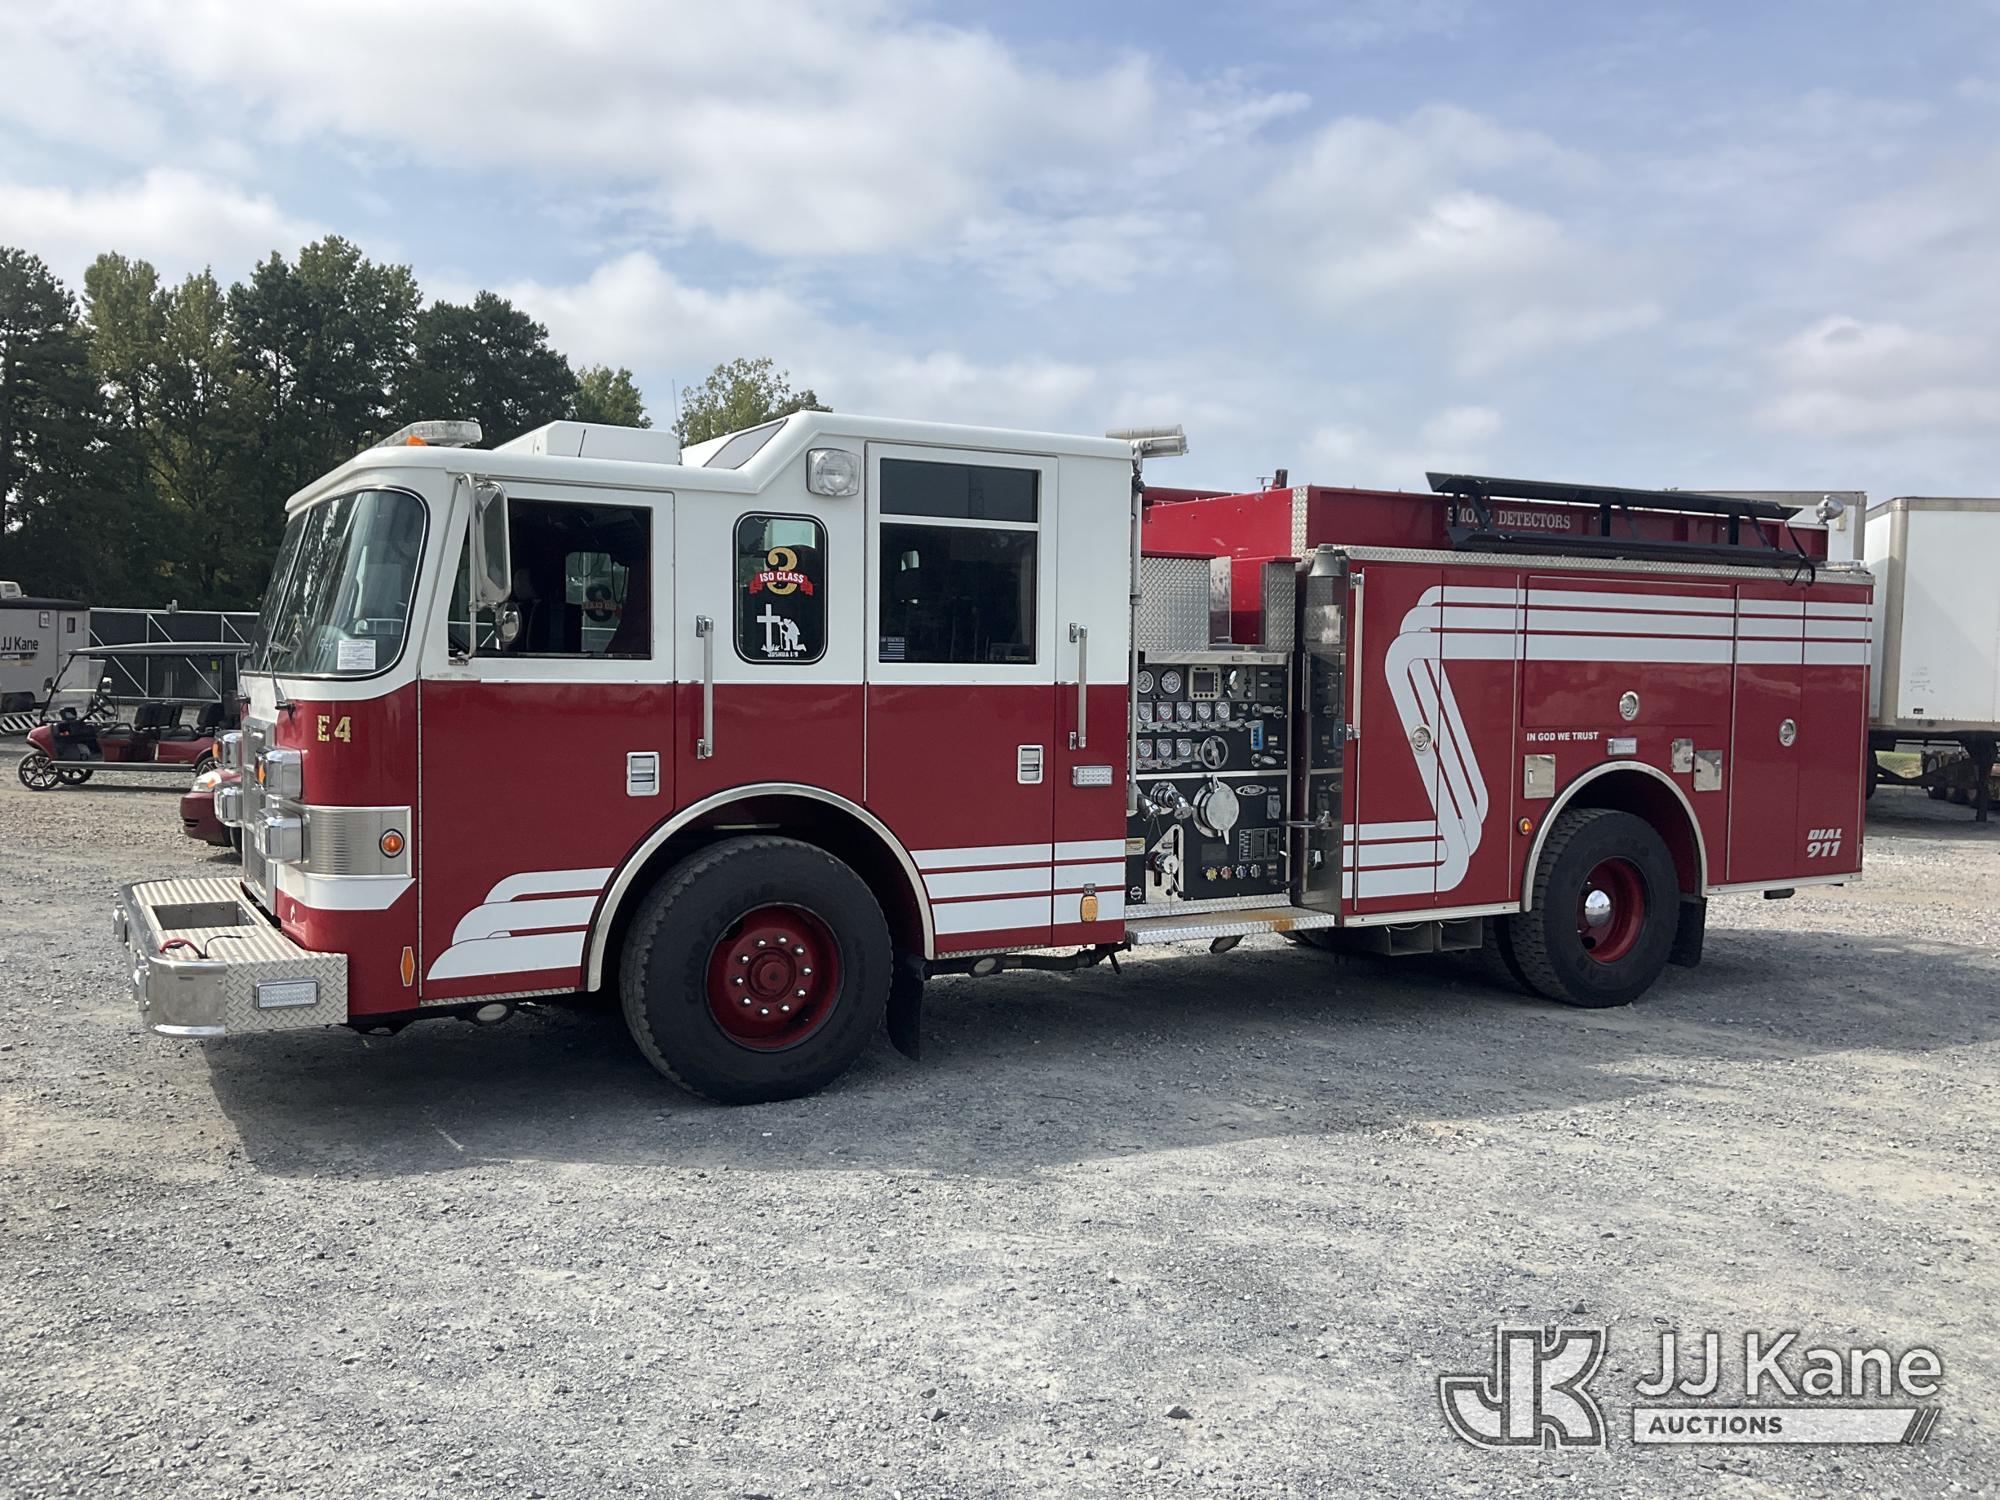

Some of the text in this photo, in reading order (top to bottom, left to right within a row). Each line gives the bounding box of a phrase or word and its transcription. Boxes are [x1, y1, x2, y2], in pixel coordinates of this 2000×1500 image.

[1498, 509, 1571, 529] DETECTORS
[759, 572, 804, 584] ISO CLASS
[1, 636, 39, 651] JJ Kane
[1526, 731, 1599, 742] IN GOD WE TRUST
[1807, 828, 1842, 840] DIAL
[1807, 840, 1841, 858] 911
